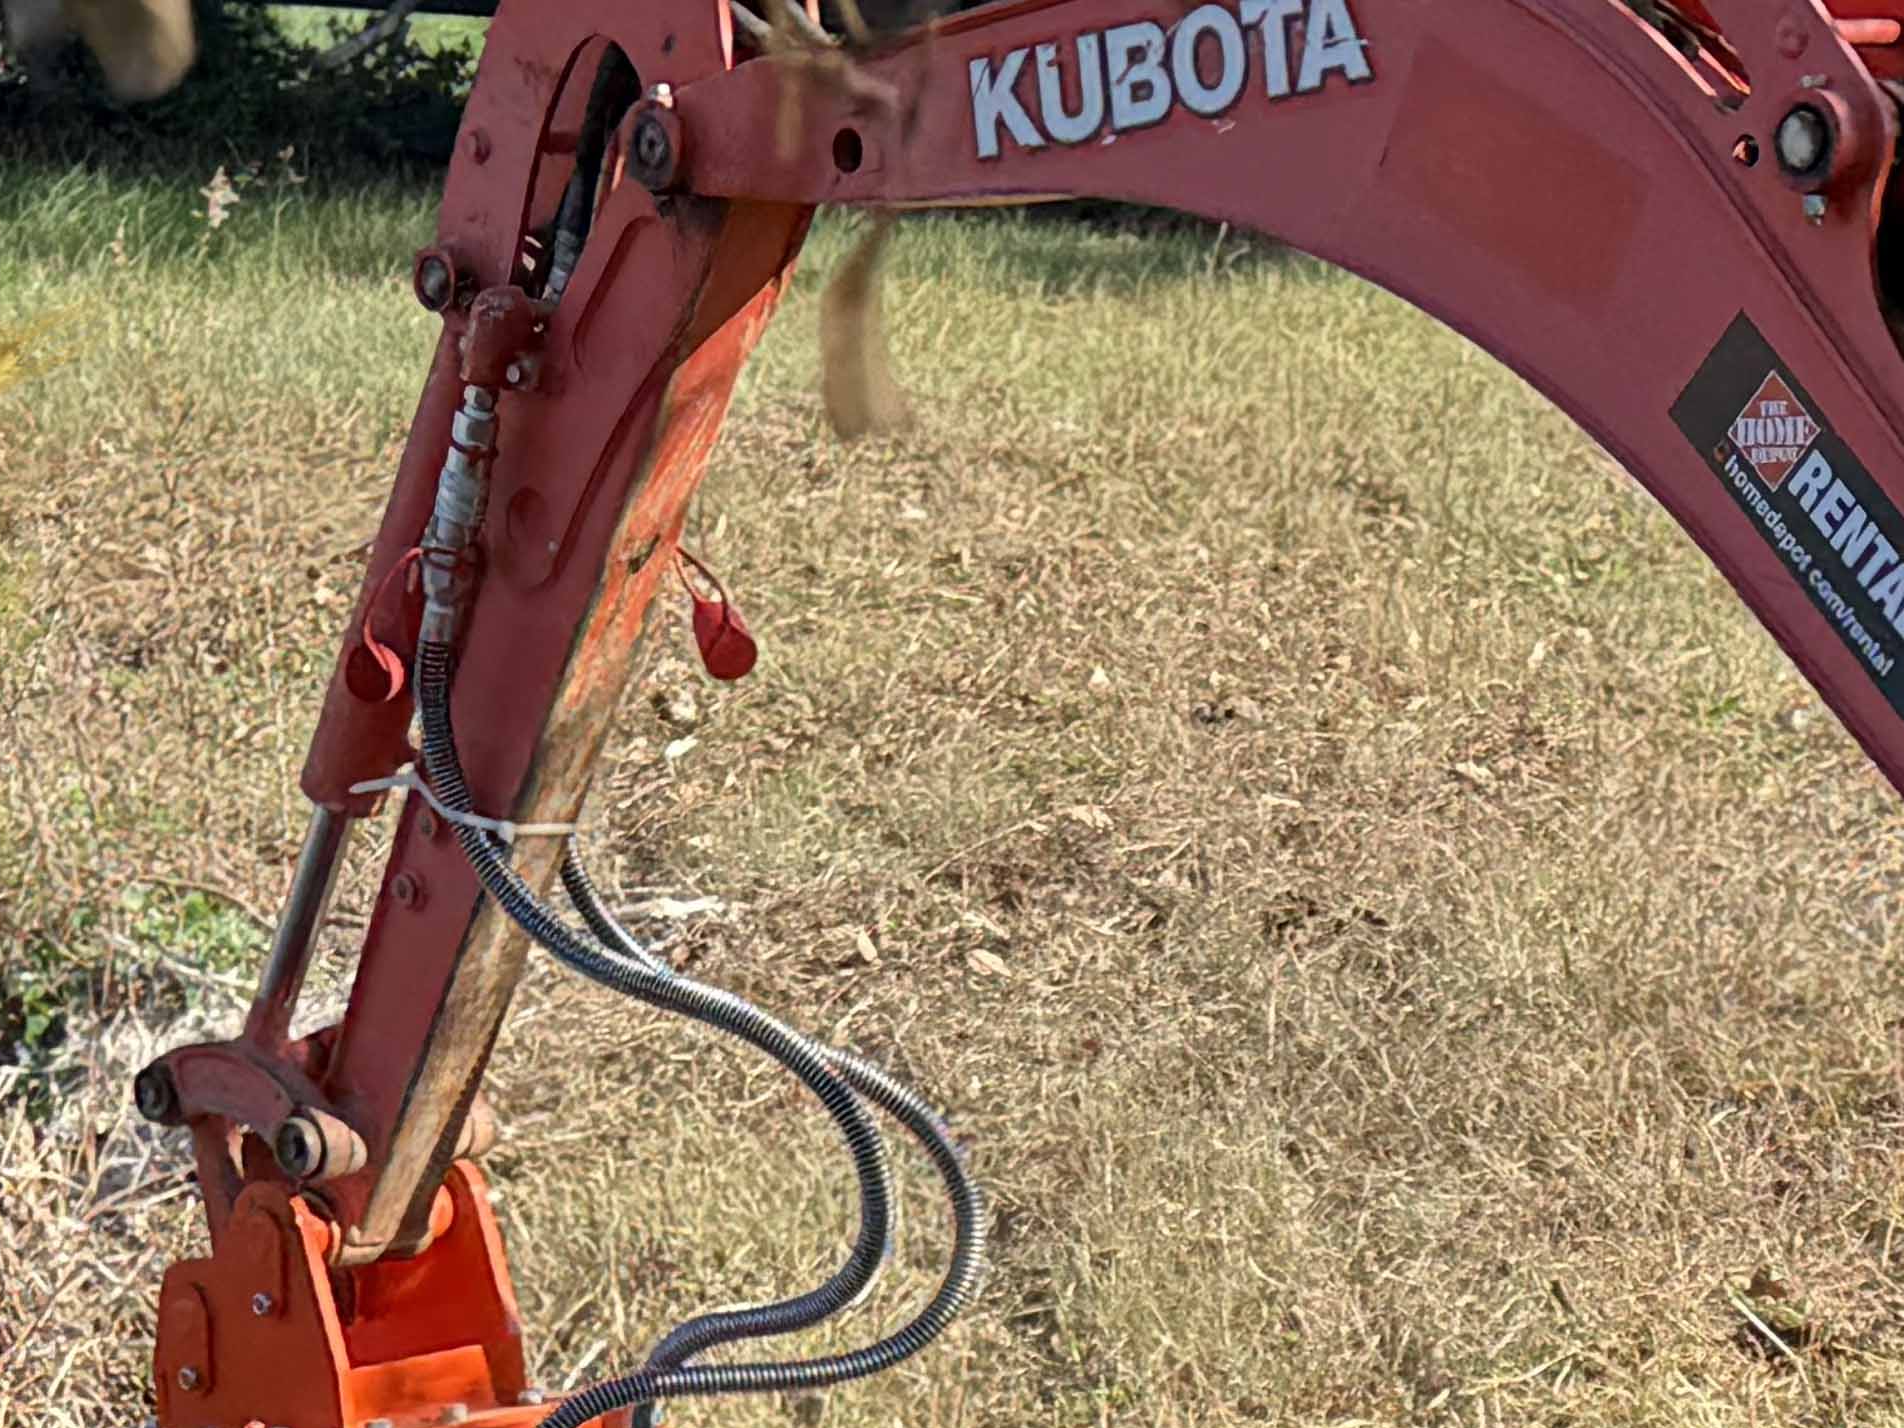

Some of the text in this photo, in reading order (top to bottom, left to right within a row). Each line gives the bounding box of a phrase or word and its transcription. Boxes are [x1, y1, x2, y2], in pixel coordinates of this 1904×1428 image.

[969, 0, 1374, 159] KUBOTA
[1737, 417, 1809, 445] HOME
[1724, 454, 1894, 677] homedepotcom/rental
